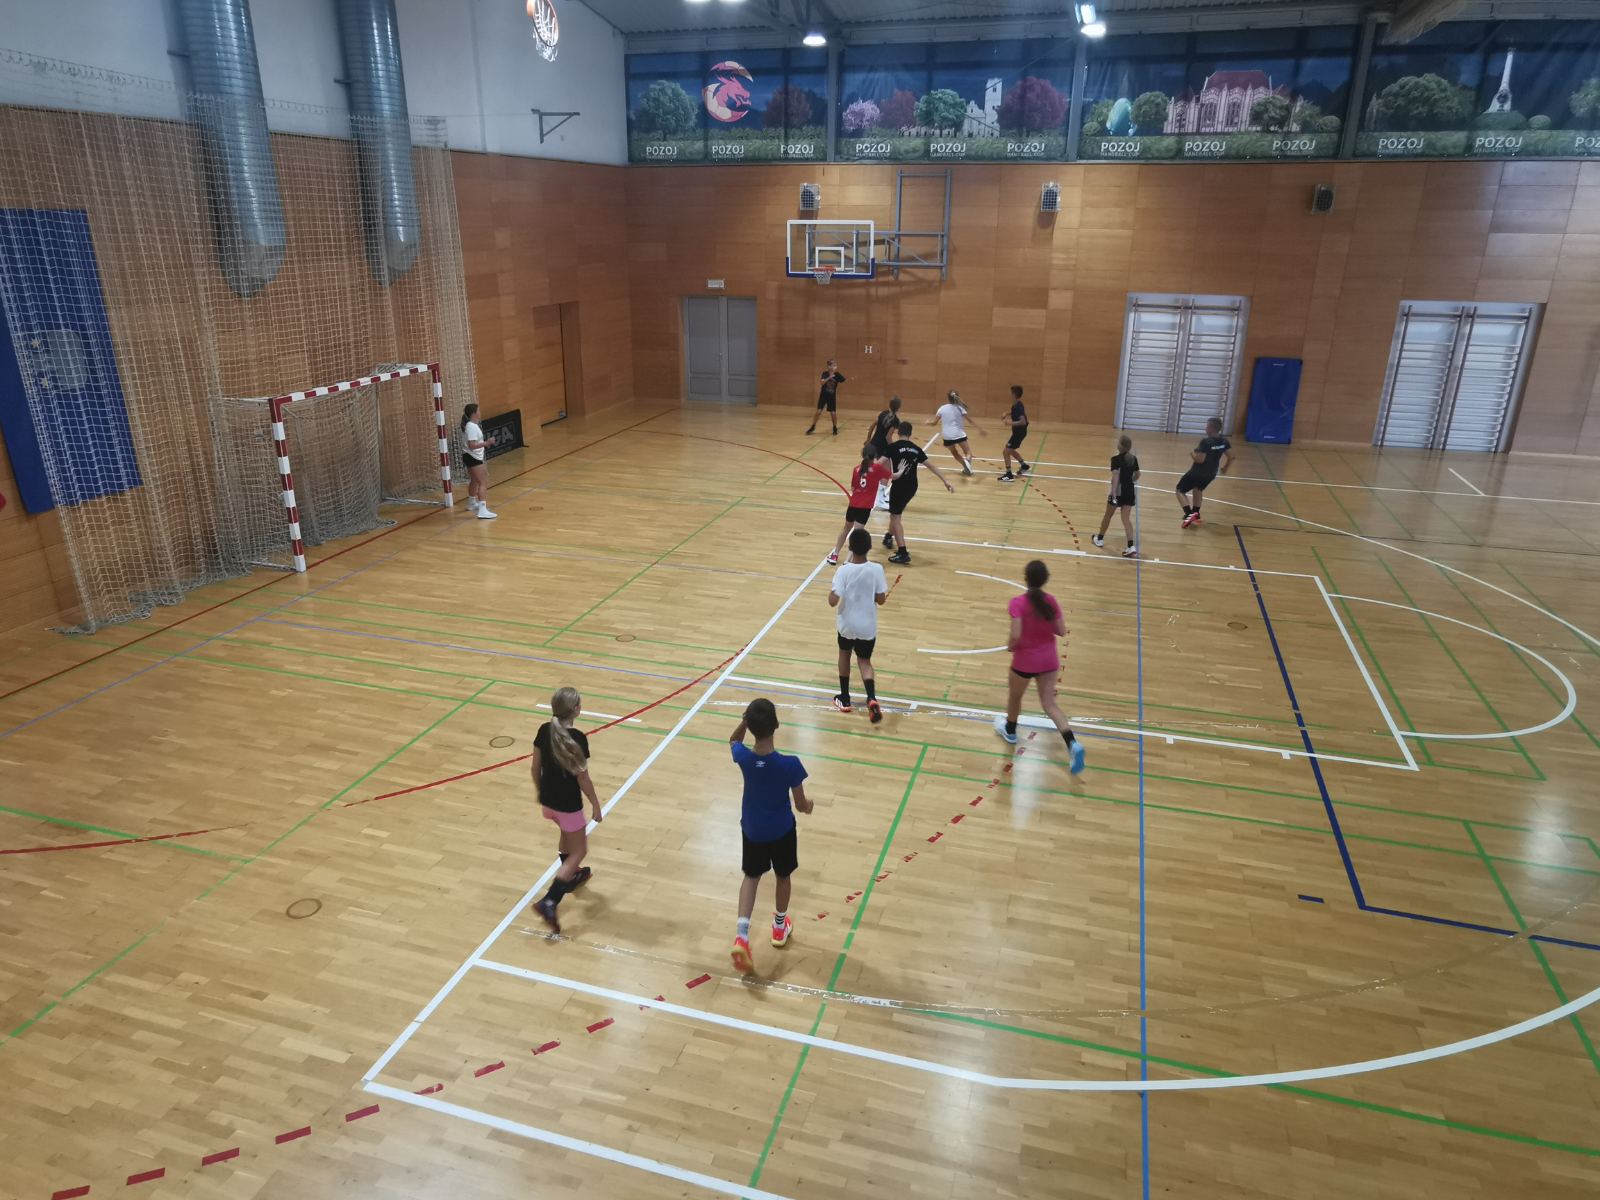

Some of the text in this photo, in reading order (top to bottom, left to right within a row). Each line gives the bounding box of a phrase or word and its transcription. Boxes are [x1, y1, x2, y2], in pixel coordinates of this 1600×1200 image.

[1101, 142, 1140, 152] POZOJ
[1185, 141, 1226, 152] POZOJ
[1272, 139, 1316, 150] POZOJ
[1378, 138, 1424, 149] POZOJ
[1475, 136, 1523, 148] POZOJ
[646, 146, 677, 155] POZOJ
[712, 144, 744, 154] POZOJ
[780, 144, 814, 154] POZOJ
[856, 143, 890, 152] POZOJ
[930, 143, 966, 153] POZOJ
[1007, 142, 1045, 153] POZOJ
[864, 345, 872, 353] H
